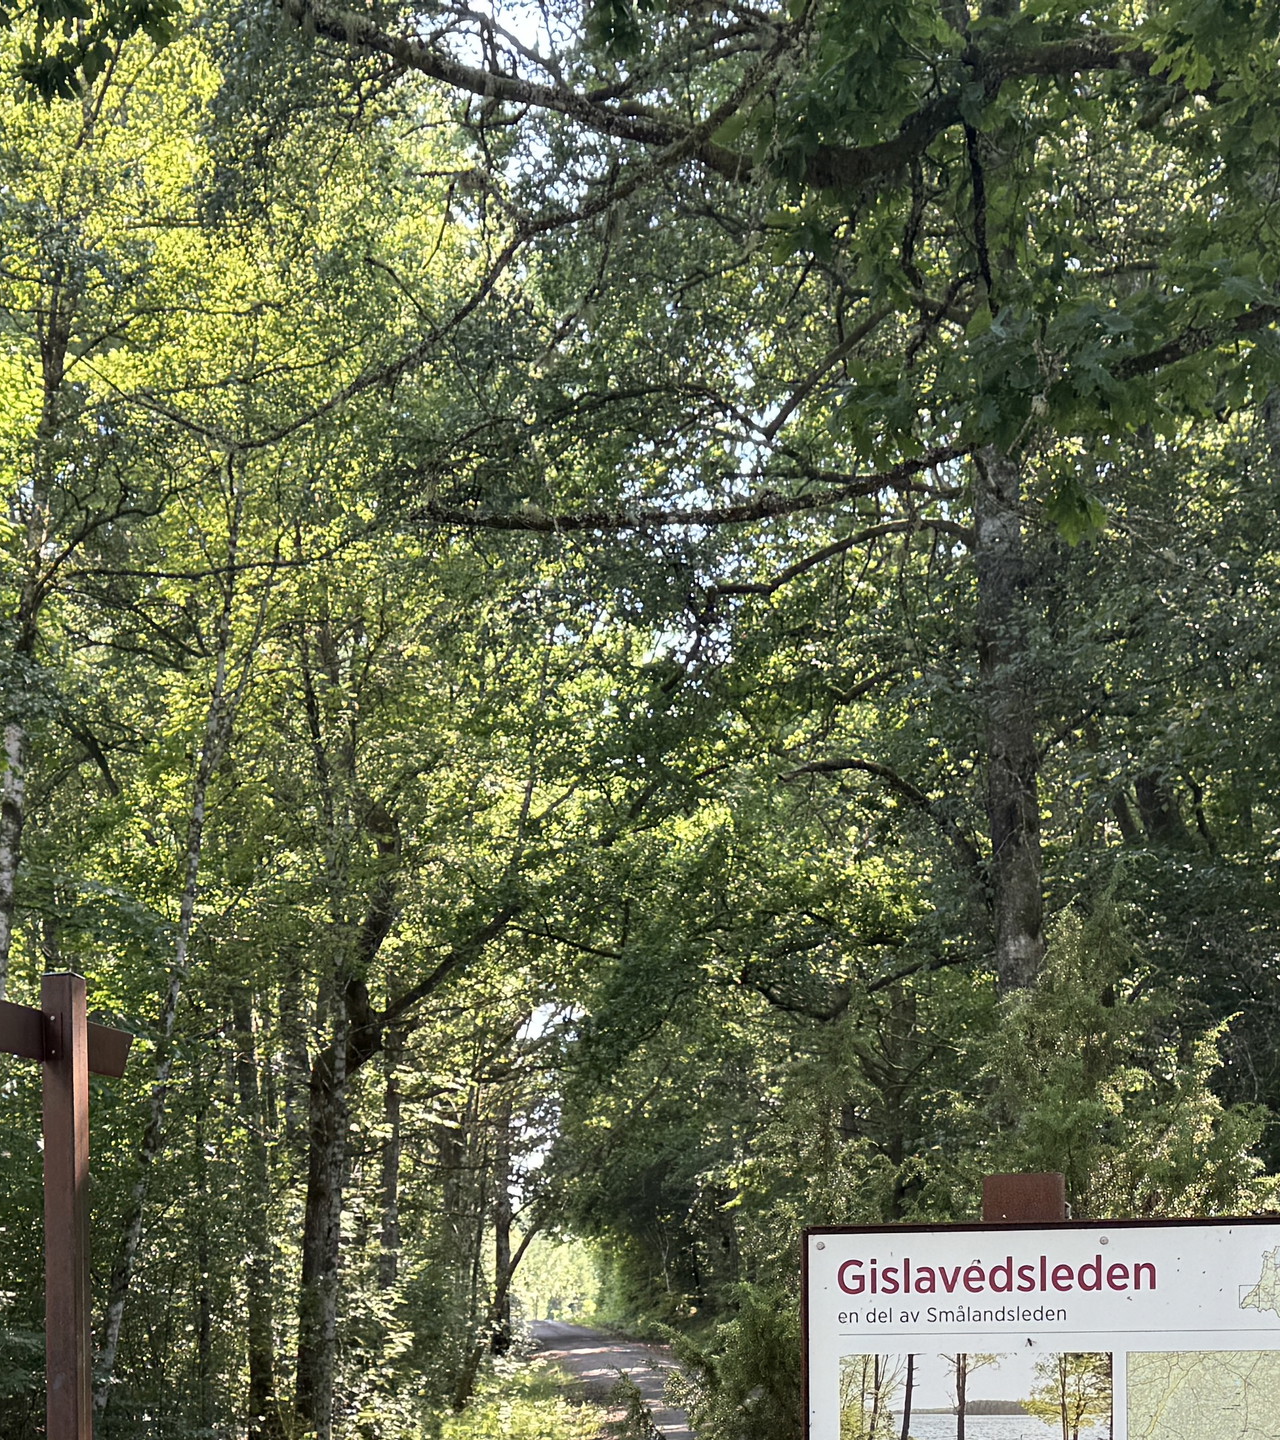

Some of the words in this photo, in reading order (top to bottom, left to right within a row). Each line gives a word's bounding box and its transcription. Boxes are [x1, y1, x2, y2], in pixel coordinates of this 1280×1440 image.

[837, 1255, 1157, 1294] Gislavedsleden
[838, 1312, 859, 1324] en
[866, 1308, 892, 1323] del
[900, 1311, 920, 1322] av
[928, 1306, 1066, 1322] Smålandsleden
